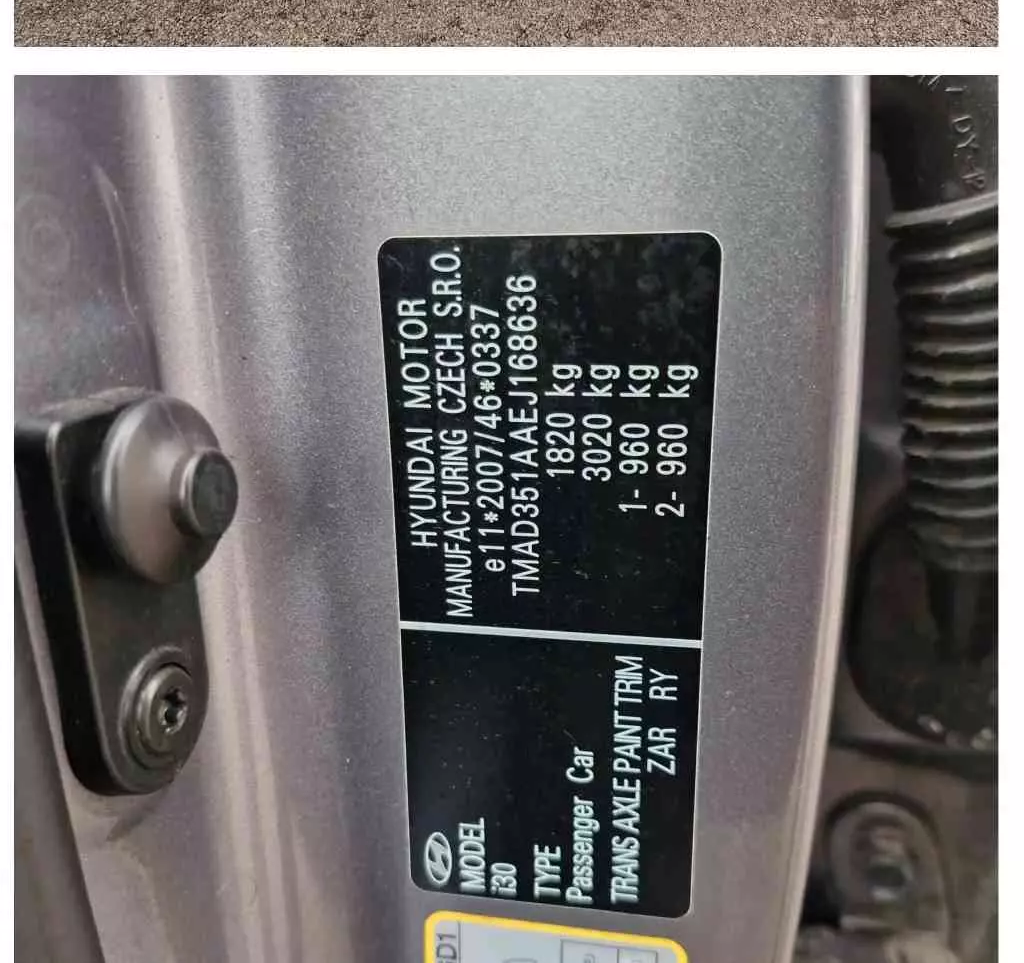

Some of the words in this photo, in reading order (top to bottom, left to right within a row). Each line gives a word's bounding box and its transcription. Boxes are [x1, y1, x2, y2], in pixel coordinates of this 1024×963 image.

[429, 245, 463, 318] S.R.O.
[397, 298, 432, 409] MOTOR
[434, 333, 467, 414] CZECH
[544, 364, 582, 398] kg
[582, 364, 620, 398] kg
[619, 364, 659, 399] kg
[658, 364, 698, 399] kg
[506, 274, 540, 597] TMAD351AAEJ168636
[544, 412, 576, 478] 1820
[581, 413, 613, 482] 3020
[618, 423, 650, 475] 960
[655, 423, 689, 476] 960
[406, 427, 438, 548] HYUNDAI
[618, 489, 648, 513] 1-
[654, 491, 685, 518] 2-
[438, 428, 473, 617] MANUFACTURING
[613, 655, 644, 707] TRIM
[648, 668, 679, 701] RY
[565, 746, 595, 784] Car
[612, 709, 643, 774] PAINT
[646, 726, 677, 776] ZAR
[612, 777, 641, 835] AXLE
[458, 817, 486, 891] MODEL
[533, 844, 562, 899] TYPE
[565, 795, 600, 905] Passenger
[610, 835, 640, 904] TRANS
[490, 863, 517, 898] i30
